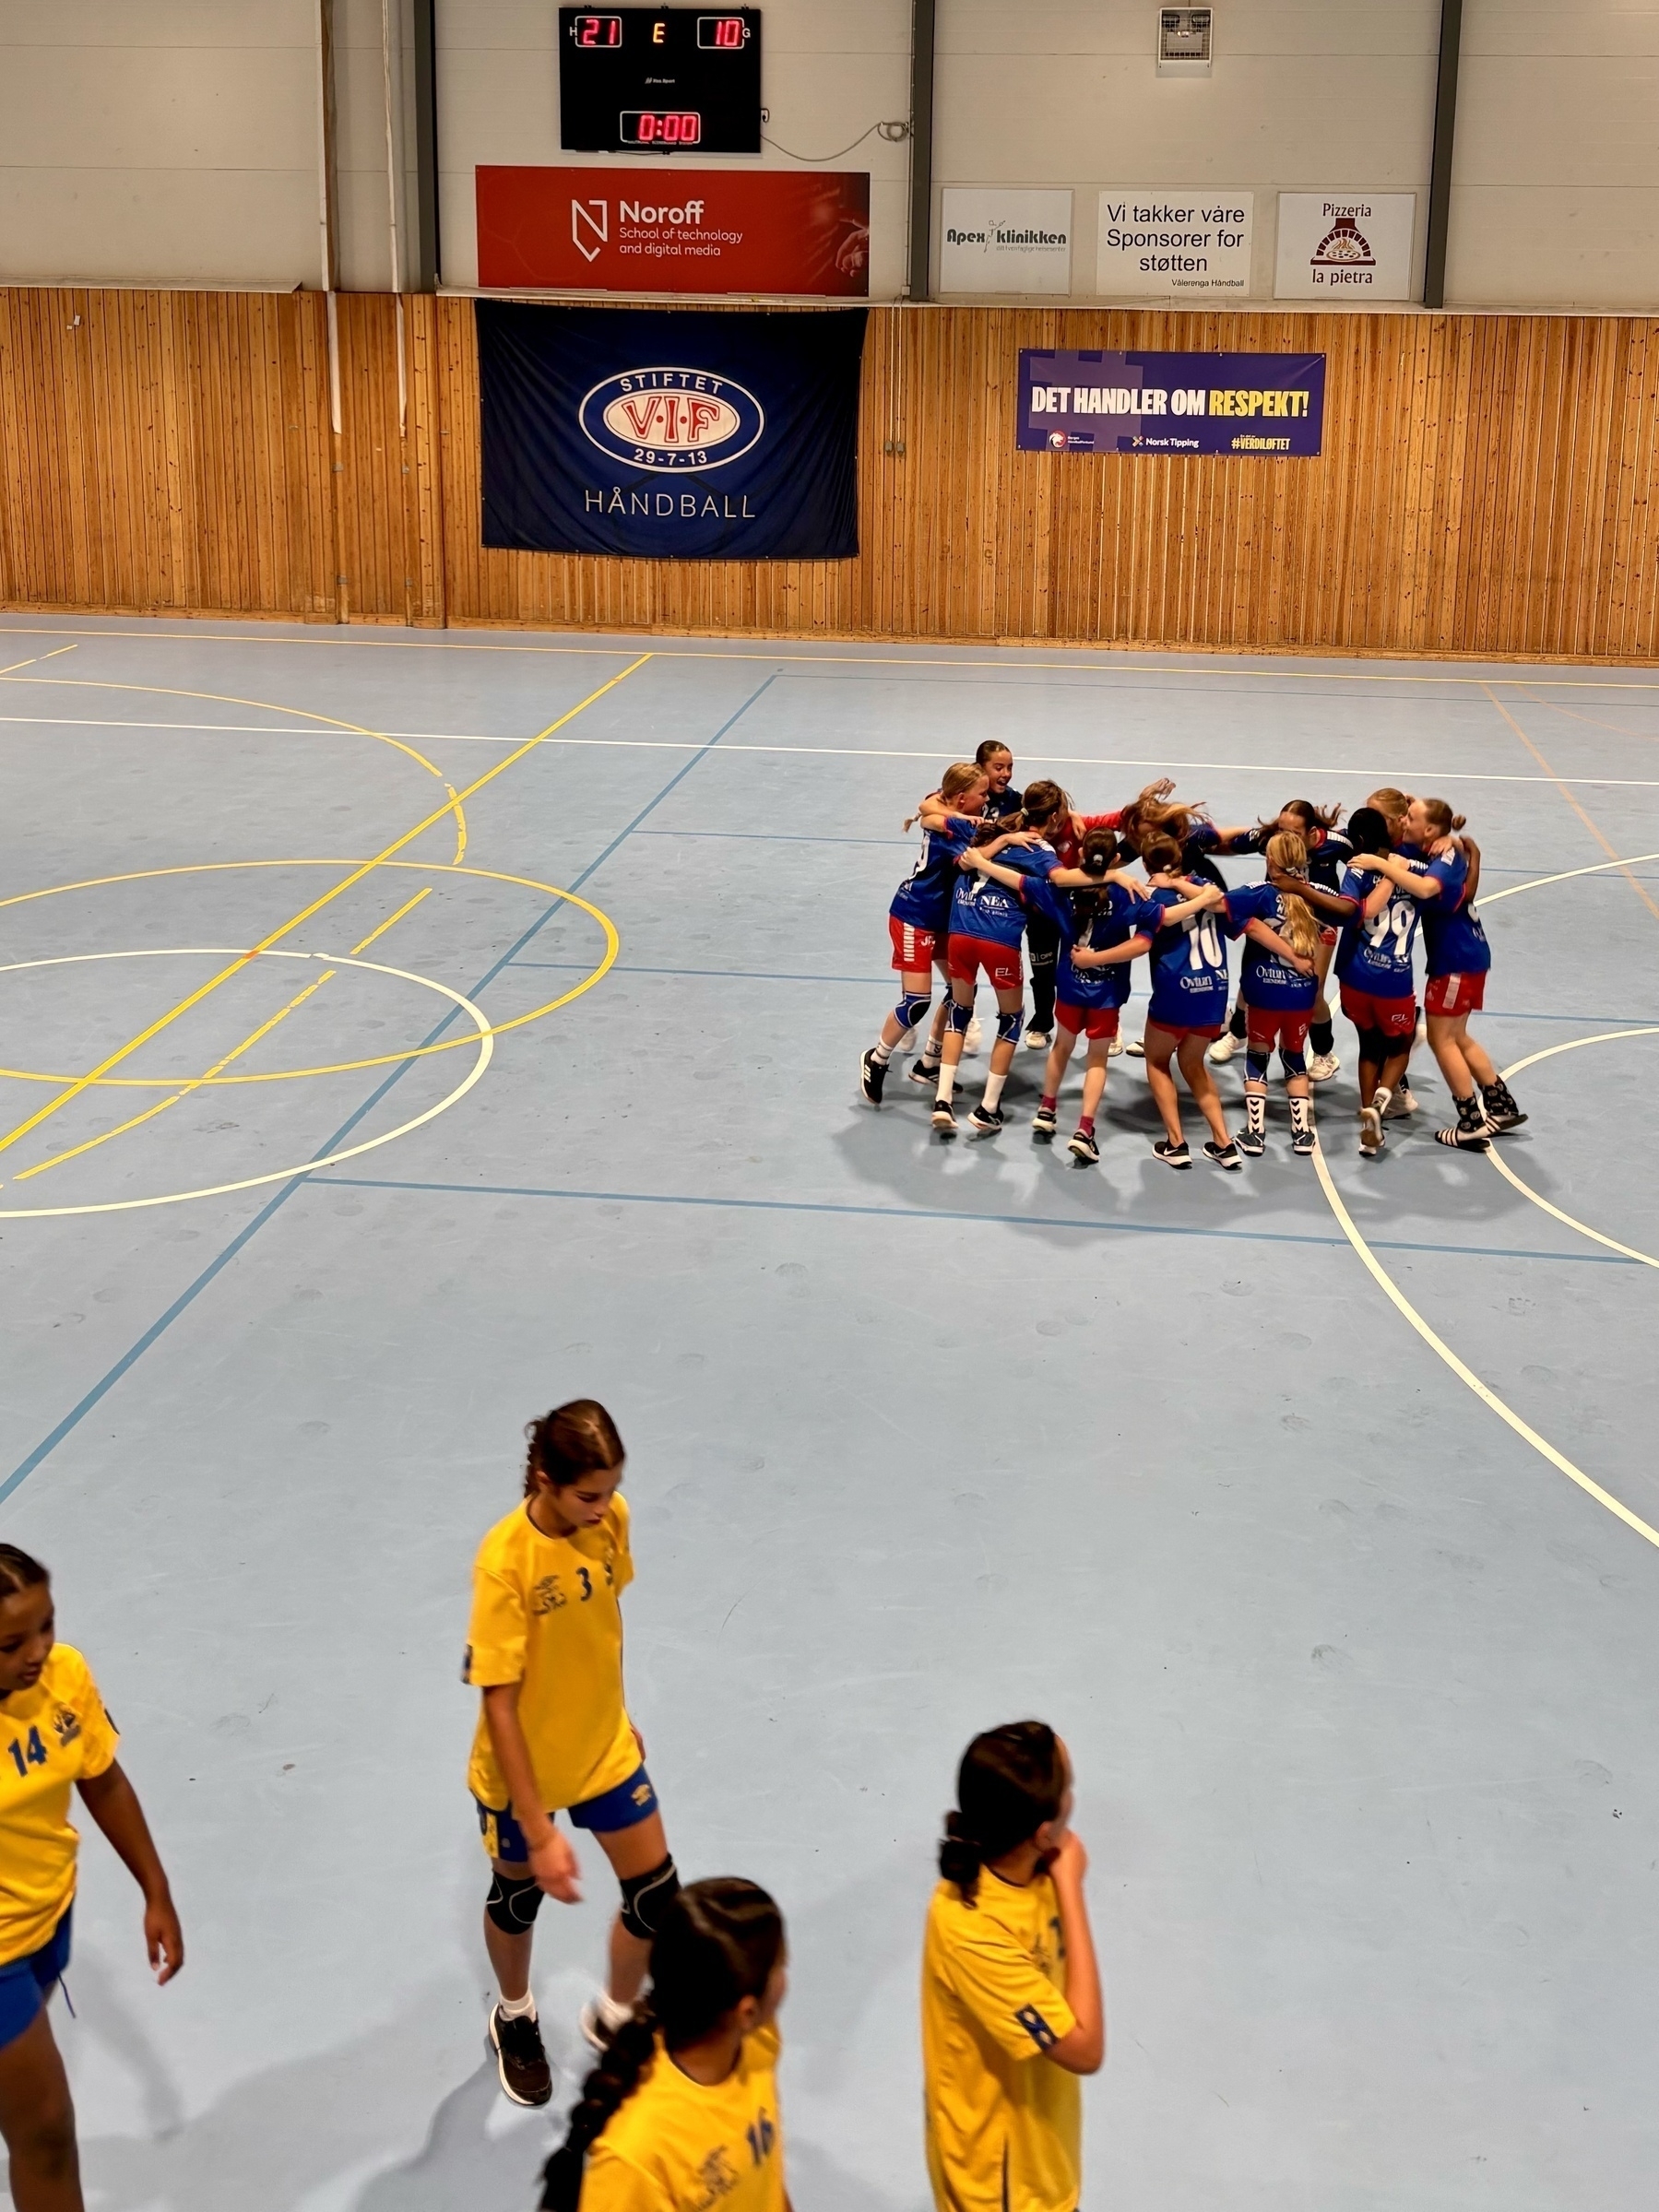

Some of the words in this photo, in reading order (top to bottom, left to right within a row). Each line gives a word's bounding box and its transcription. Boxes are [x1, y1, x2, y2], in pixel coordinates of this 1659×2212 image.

[569, 27, 577, 37] H
[582, 18, 617, 45] 21
[652, 22, 666, 43] E
[715, 20, 740, 46] 10
[741, 28, 751, 39] G
[638, 113, 697, 141] 0:00
[619, 199, 705, 225] Noroff
[1107, 204, 1126, 222] Vi
[1132, 205, 1195, 223] takker
[1201, 205, 1245, 223] våre
[1322, 203, 1371, 218] Pizzeria
[619, 227, 659, 240] School
[661, 228, 675, 240] of
[677, 229, 743, 244] technology
[946, 229, 986, 245] Apex
[996, 229, 1067, 244] klinikken
[1107, 229, 1212, 251] Sponsorer
[1216, 230, 1245, 247] for
[619, 242, 642, 254] and
[644, 242, 682, 257] digital
[684, 244, 721, 256] media
[1139, 254, 1207, 272] støtten
[1171, 279, 1210, 289] Vålerenga
[1312, 269, 1324, 284] la
[1330, 269, 1373, 286] pietra
[620, 373, 723, 395] STIFTET
[1031, 386, 1072, 413] DET
[1072, 387, 1167, 416] HANDLER
[1170, 389, 1205, 416] OM
[1208, 390, 1310, 418] RESPEKT!
[1145, 437, 1169, 446] Norsk
[1169, 438, 1200, 449] Tipping
[634, 448, 708, 466] 29-7-13
[585, 487, 756, 518] HÅNDBALL
[979, 894, 1010, 909] NEA
[1180, 911, 1224, 971] 10
[575, 1567, 593, 1603] 3
[7, 1724, 48, 1778] 14
